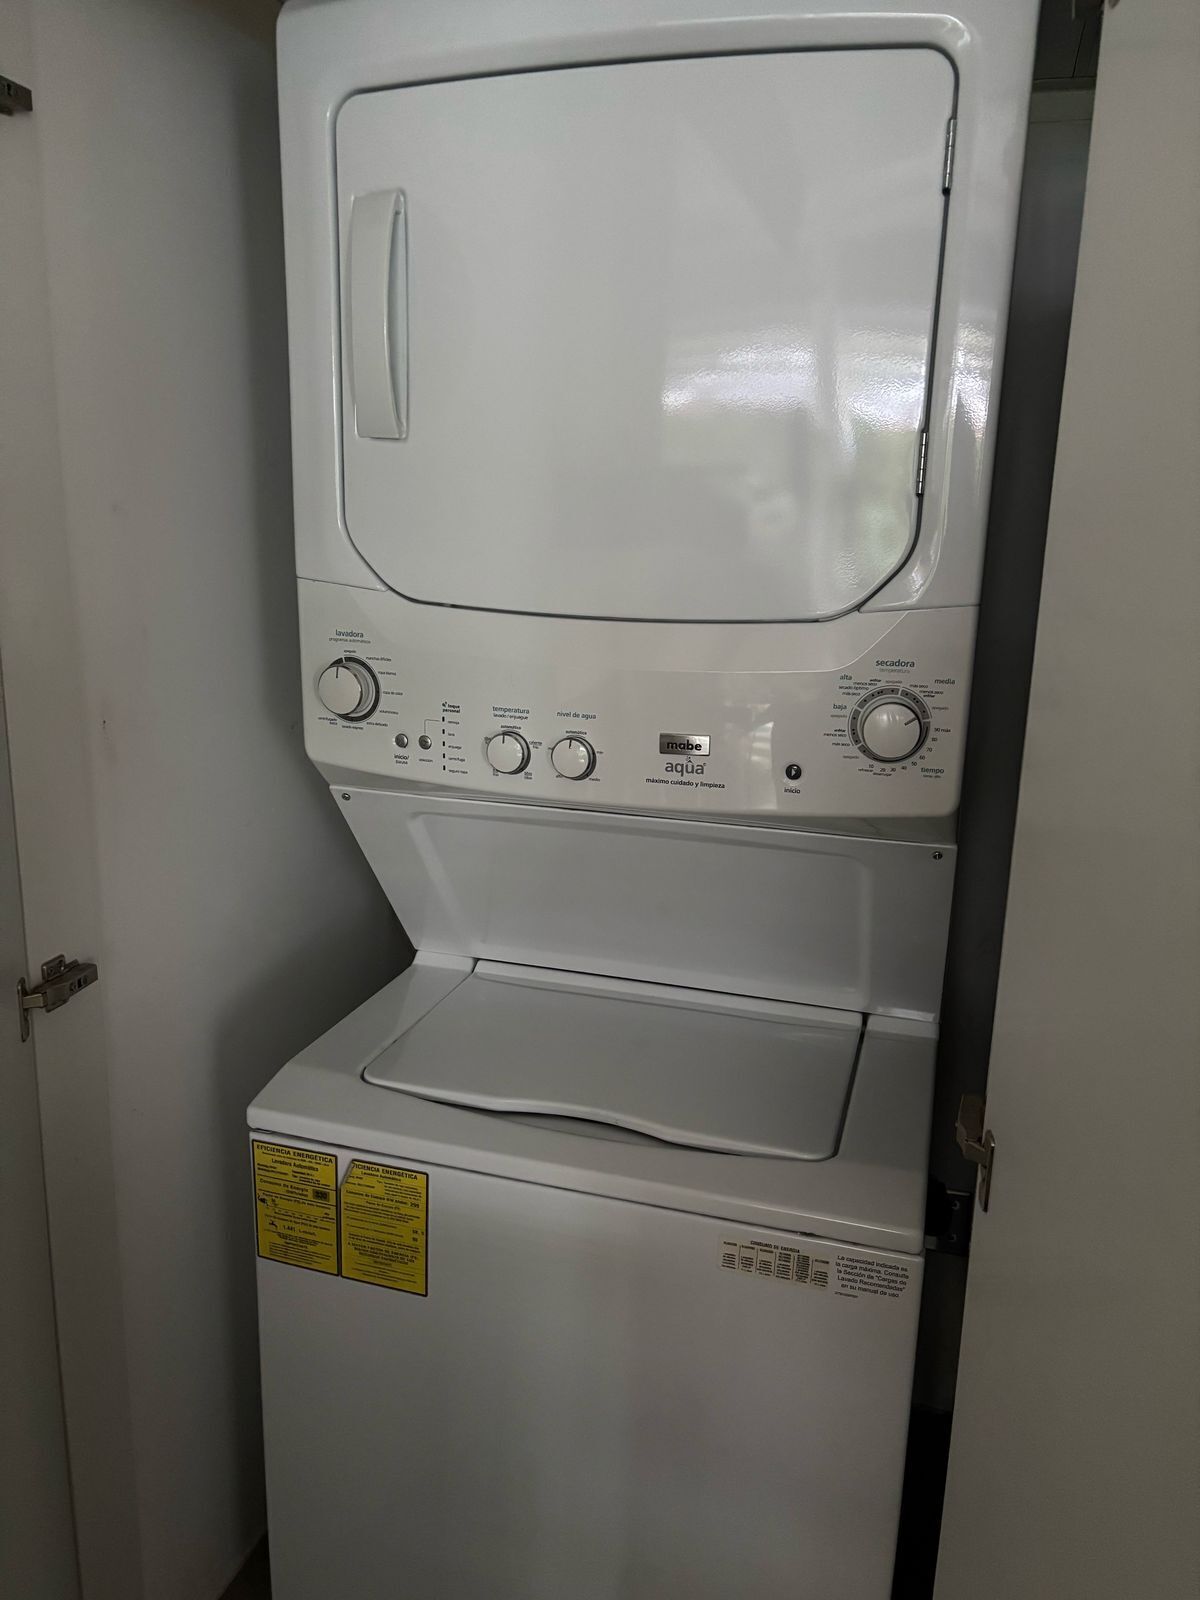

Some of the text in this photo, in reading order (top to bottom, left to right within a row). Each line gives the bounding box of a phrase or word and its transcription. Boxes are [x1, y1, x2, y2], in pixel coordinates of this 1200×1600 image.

[335, 629, 364, 638] lavadora
[875, 659, 915, 667] secadora
[492, 705, 530, 715] temperatura
[833, 703, 847, 711] baja
[666, 739, 703, 751] mabe
[920, 767, 945, 775] tiempo
[645, 777, 670, 785] máximo
[670, 779, 694, 787] cuidado
[700, 780, 726, 789] limpieza
[256, 1144, 291, 1156] EFICIENCIA
[846, 1257, 875, 1267] capacidad
[875, 1261, 900, 1271] indicada
[843, 1270, 866, 1278] Sección
[837, 1275, 858, 1284] Lavado
[857, 1286, 879, 1294] manual
